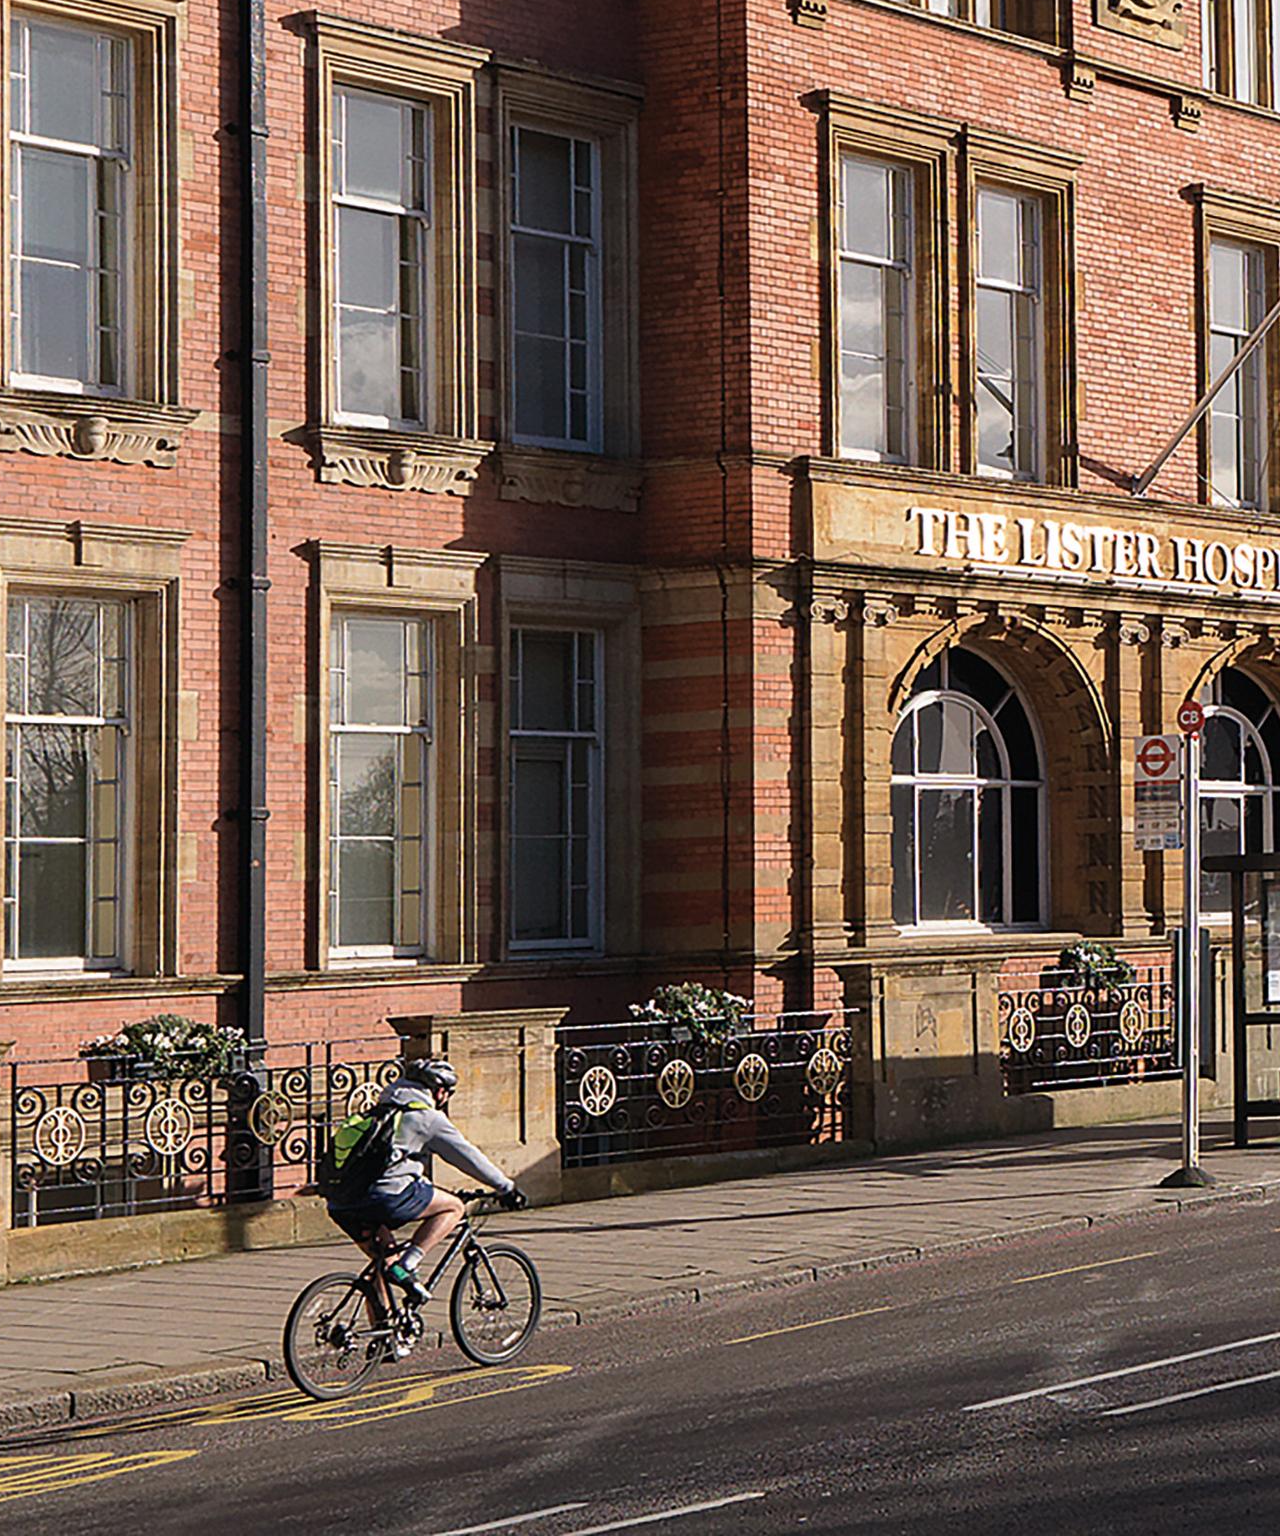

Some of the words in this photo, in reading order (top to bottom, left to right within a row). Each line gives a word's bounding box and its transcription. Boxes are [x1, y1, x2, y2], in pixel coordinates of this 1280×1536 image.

[906, 506, 1010, 563] THE
[1014, 516, 1165, 580] LISTER
[1180, 710, 1200, 724] CB
